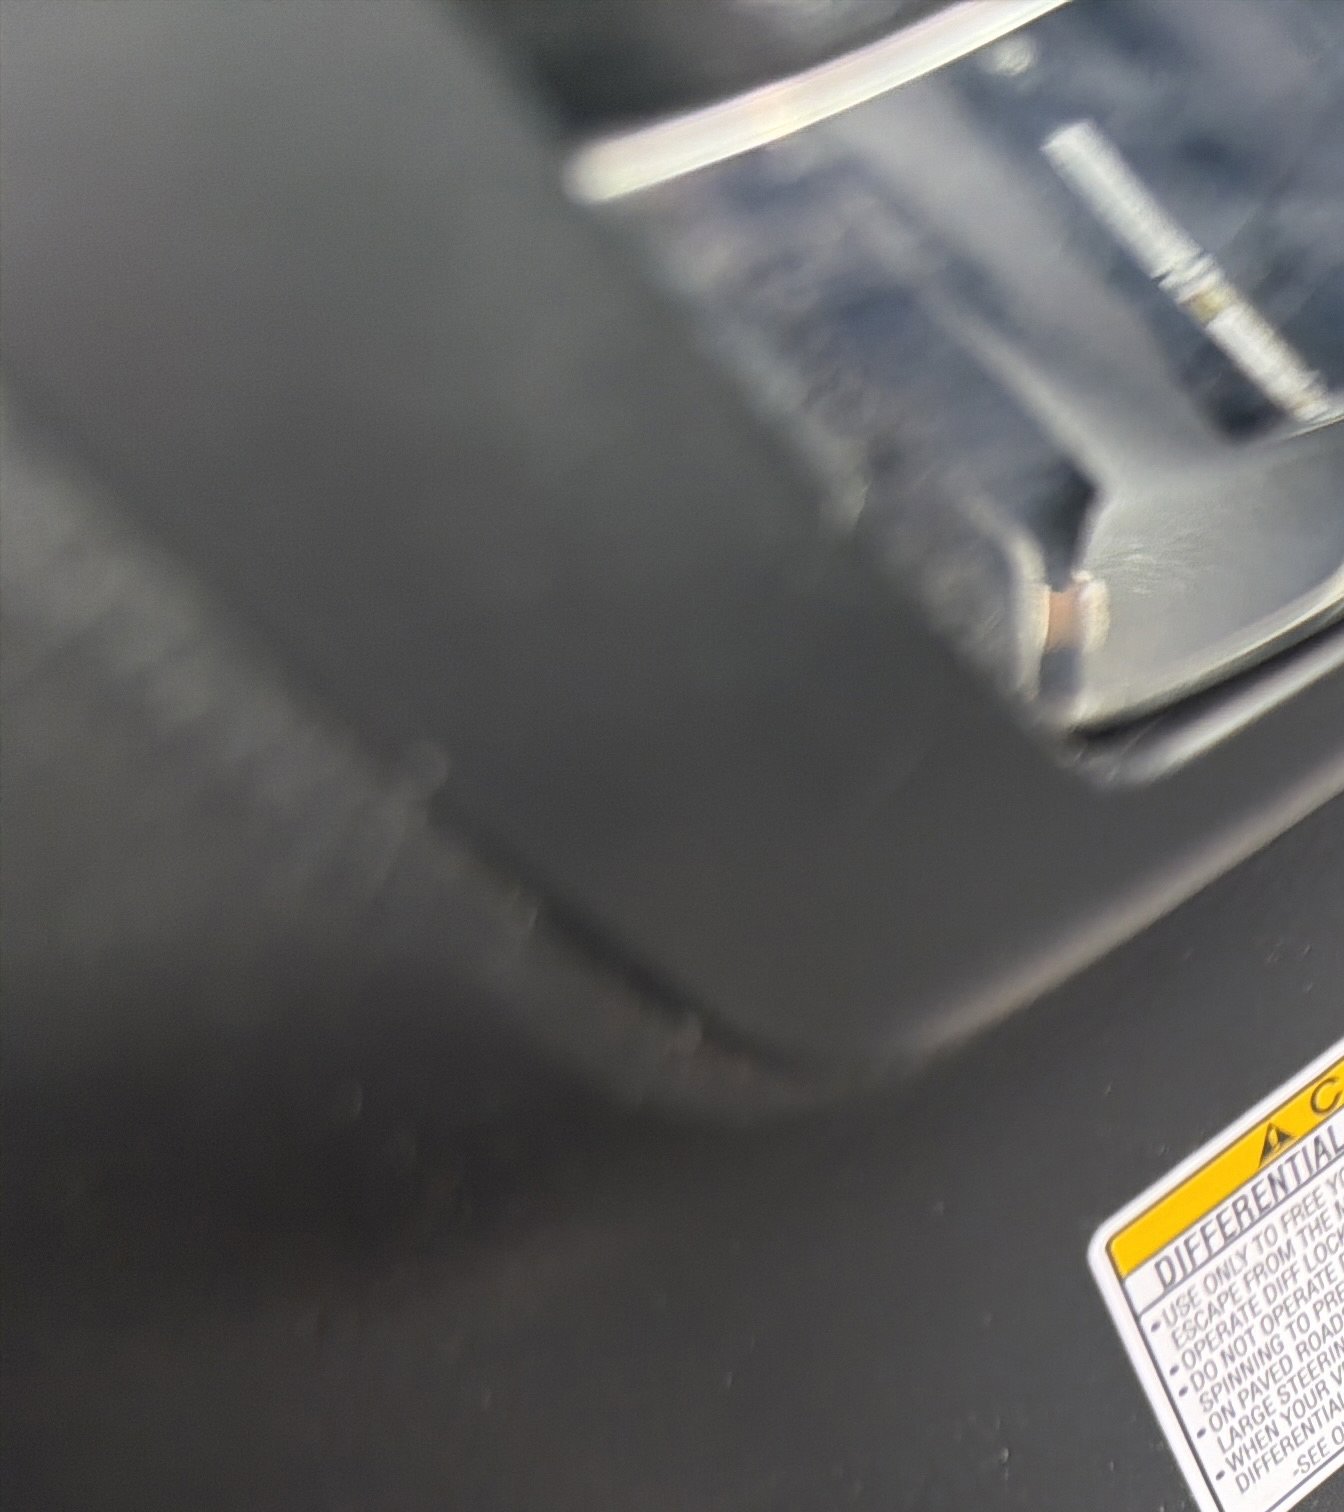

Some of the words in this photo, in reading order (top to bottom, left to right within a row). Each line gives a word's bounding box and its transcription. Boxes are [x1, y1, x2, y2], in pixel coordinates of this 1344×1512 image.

[1161, 1287, 1199, 1327] USE
[1201, 1245, 1251, 1296] ONLY
[1253, 1223, 1279, 1255] TO
[1280, 1187, 1324, 1234] FREE
[1170, 1283, 1240, 1349] ESCAPE
[1242, 1239, 1296, 1292] FROM
[1297, 1210, 1332, 1249] THE
[1180, 1295, 1261, 1371] OPERATE
[1262, 1263, 1301, 1305] DIFF
[1189, 1358, 1218, 1392] DO
[1219, 1326, 1258, 1368] NOT
[1259, 1262, 1336, 1336] OPERATE
[1198, 1333, 1284, 1413] SPINNING
[1286, 1311, 1311, 1343] TO
[1208, 1400, 1236, 1434] ON
[1237, 1353, 1294, 1410] PAVED
[1217, 1396, 1275, 1454] LARGE
[1226, 1420, 1280, 1475] WHEN
[1280, 1378, 1330, 1430] YOUR
